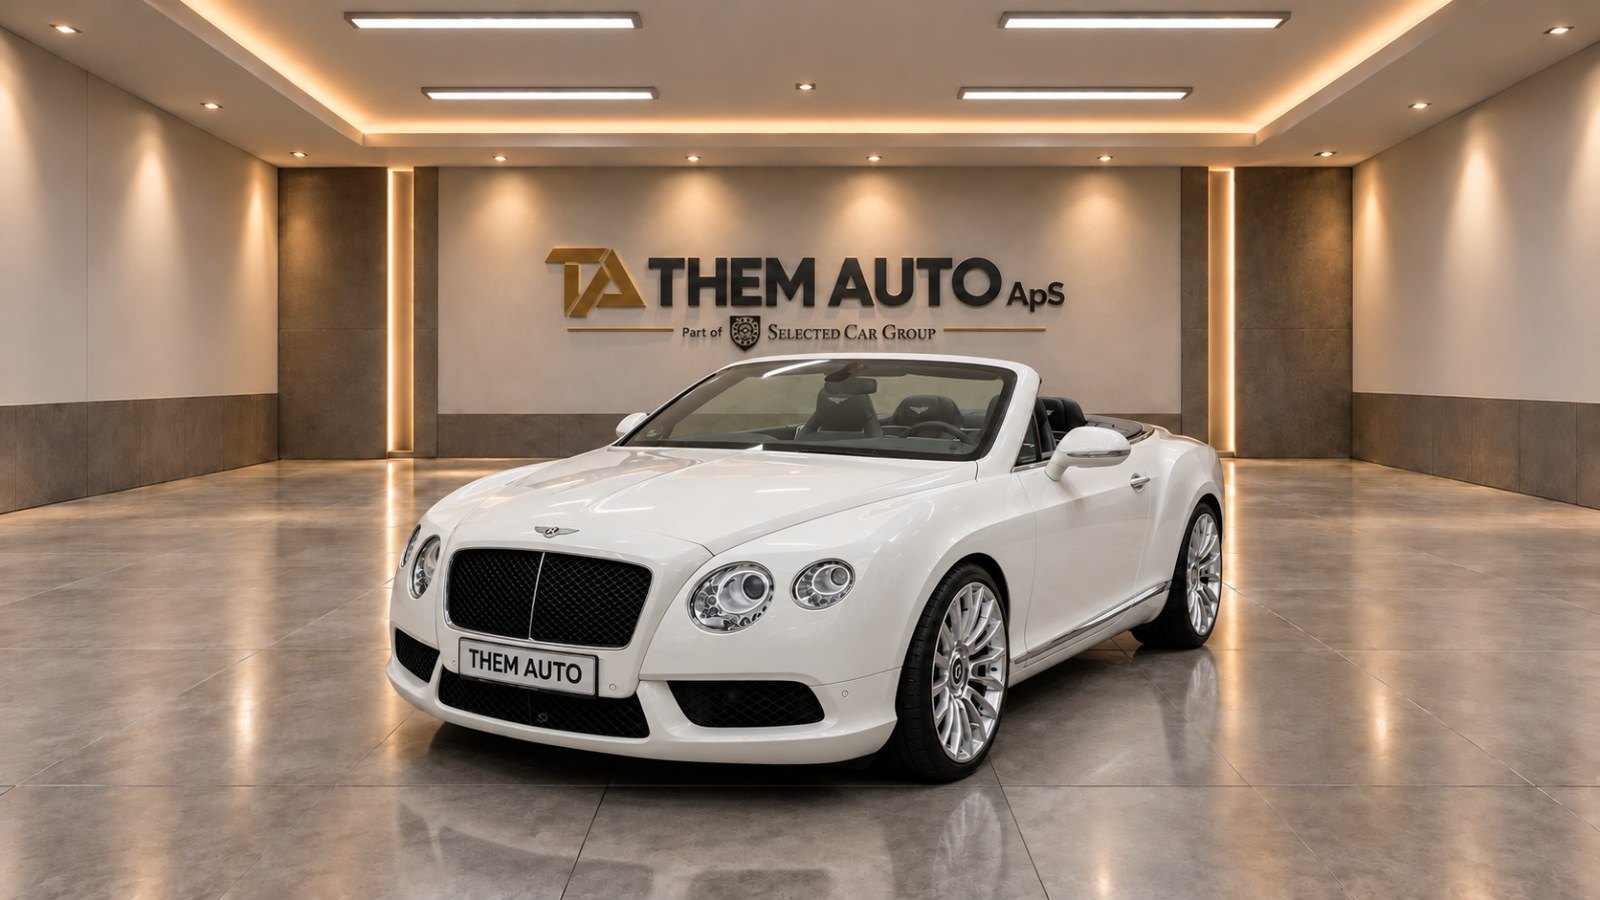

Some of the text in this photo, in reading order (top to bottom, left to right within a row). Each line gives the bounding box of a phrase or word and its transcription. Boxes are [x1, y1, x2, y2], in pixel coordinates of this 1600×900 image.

[648, 257, 1065, 313] THEM AUTO ApS
[682, 324, 936, 341] Part of SELECTED CAR GROUP
[469, 649, 582, 684] THEM AUTO
